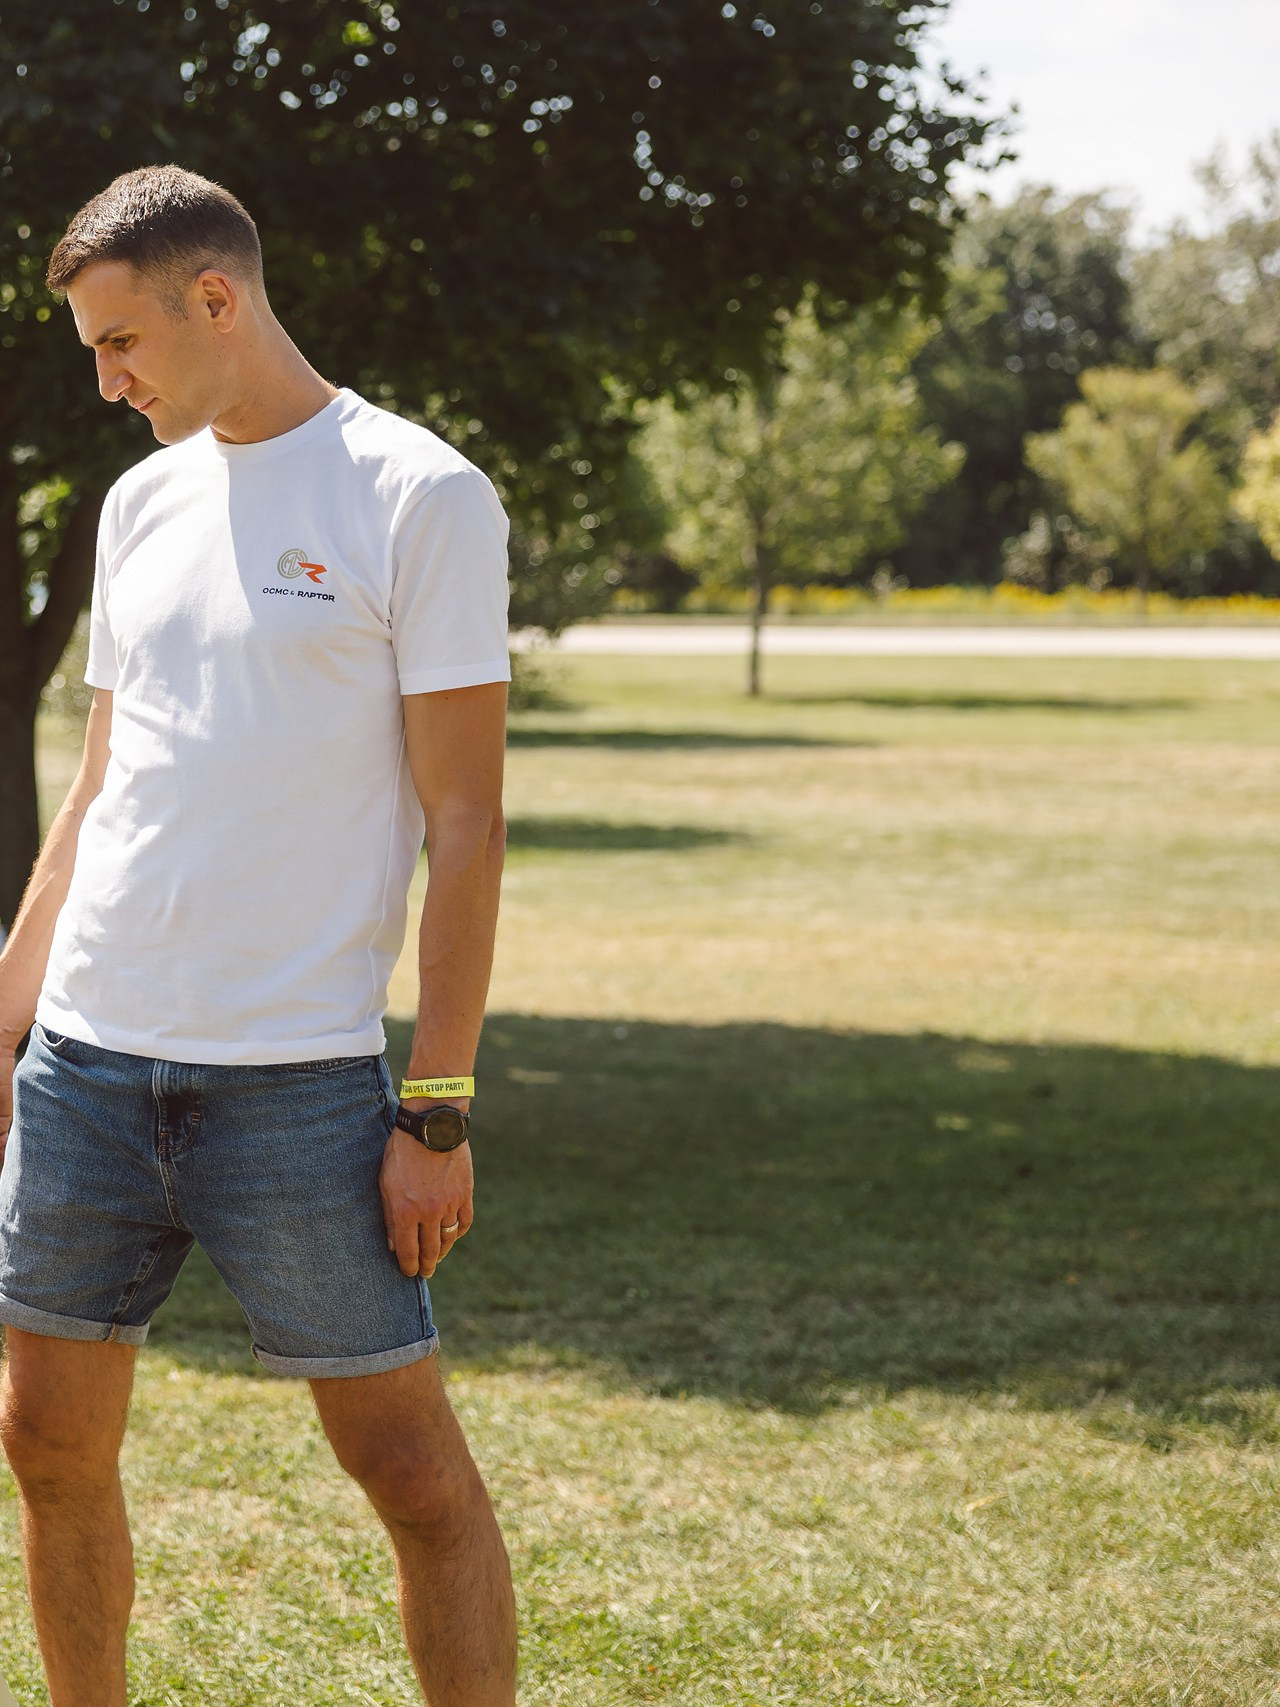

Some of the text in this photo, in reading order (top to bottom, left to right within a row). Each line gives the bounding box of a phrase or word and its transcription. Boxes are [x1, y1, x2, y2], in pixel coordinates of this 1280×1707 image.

[263, 587, 289, 596] OCMC
[297, 590, 335, 602] RAPTOR
[413, 1085, 424, 1093] PIT
[425, 1083, 445, 1092] STOP
[445, 1082, 465, 1091] PARTY
